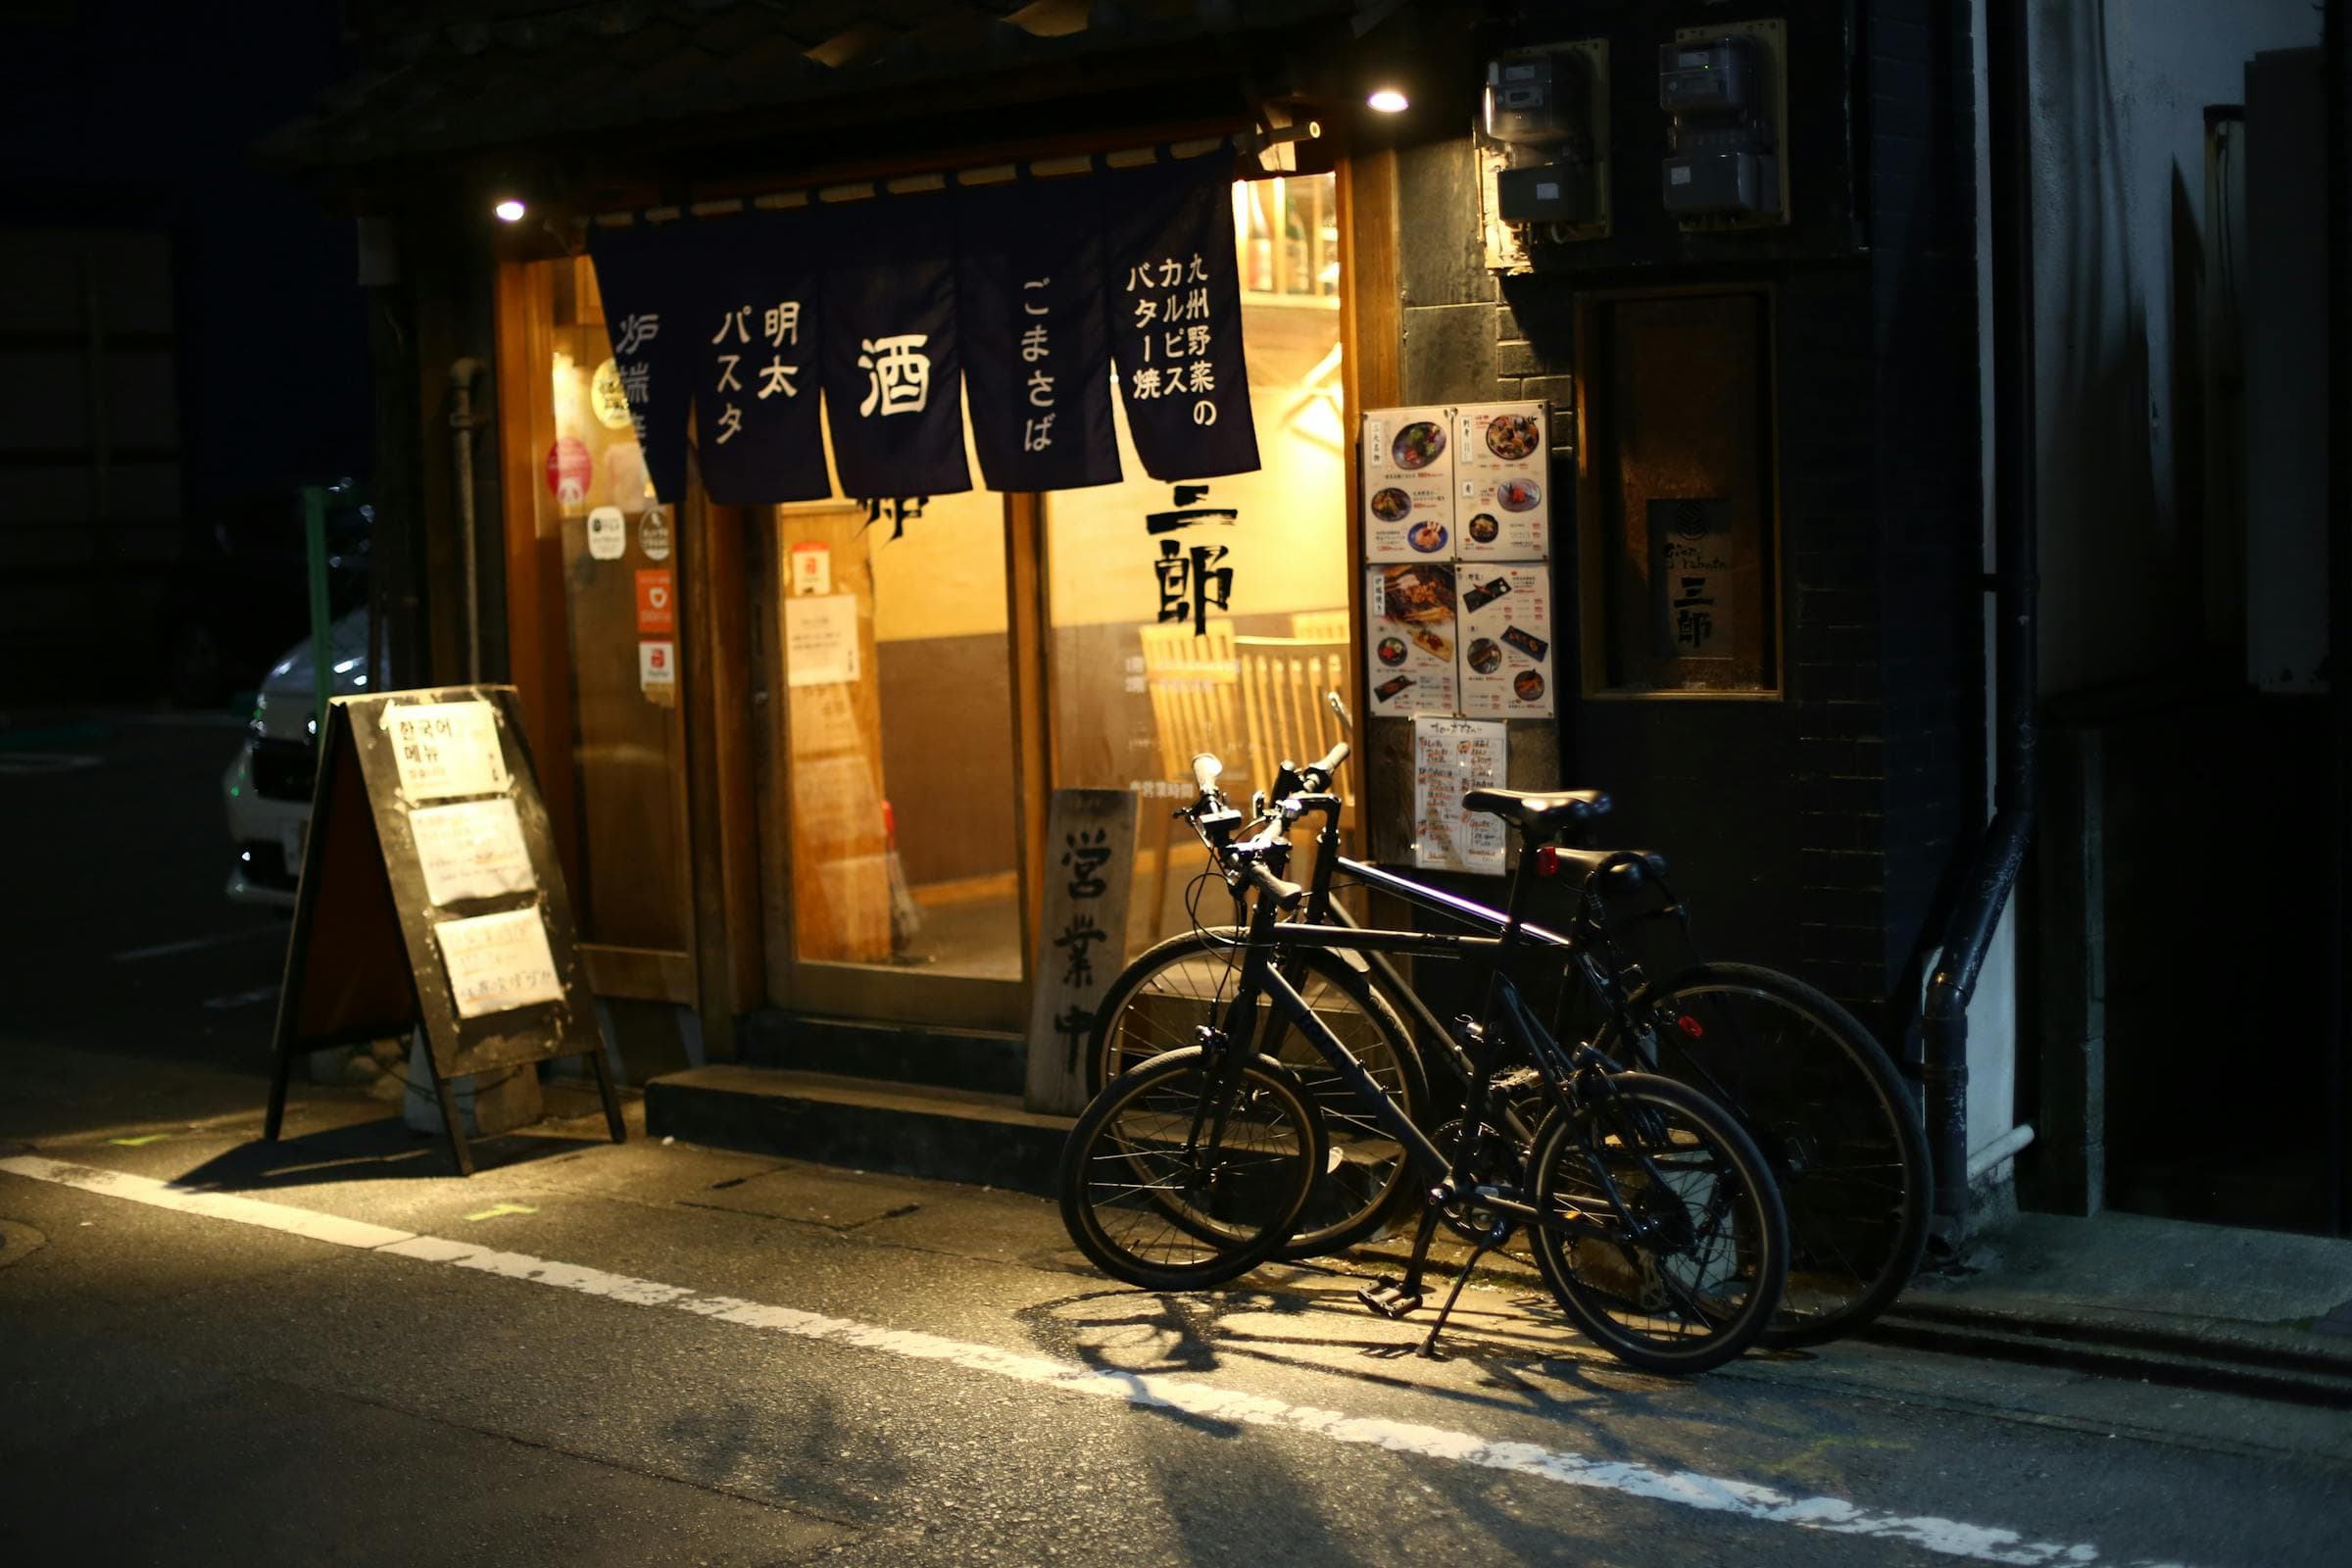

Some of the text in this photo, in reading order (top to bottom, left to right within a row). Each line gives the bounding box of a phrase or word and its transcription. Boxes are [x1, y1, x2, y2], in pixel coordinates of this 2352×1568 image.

[614, 313, 660, 456] 炉端
[711, 305, 752, 445] パスタ
[758, 301, 801, 400] 明太
[857, 332, 932, 418] 酒
[1022, 277, 1057, 453] ごまさば
[1126, 261, 1162, 401] バター焼
[1158, 257, 1188, 396] カルピス
[1186, 252, 1218, 427] 九州野菜の
[399, 718, 453, 741] 한국어
[1053, 829, 1112, 1075] 営業中
